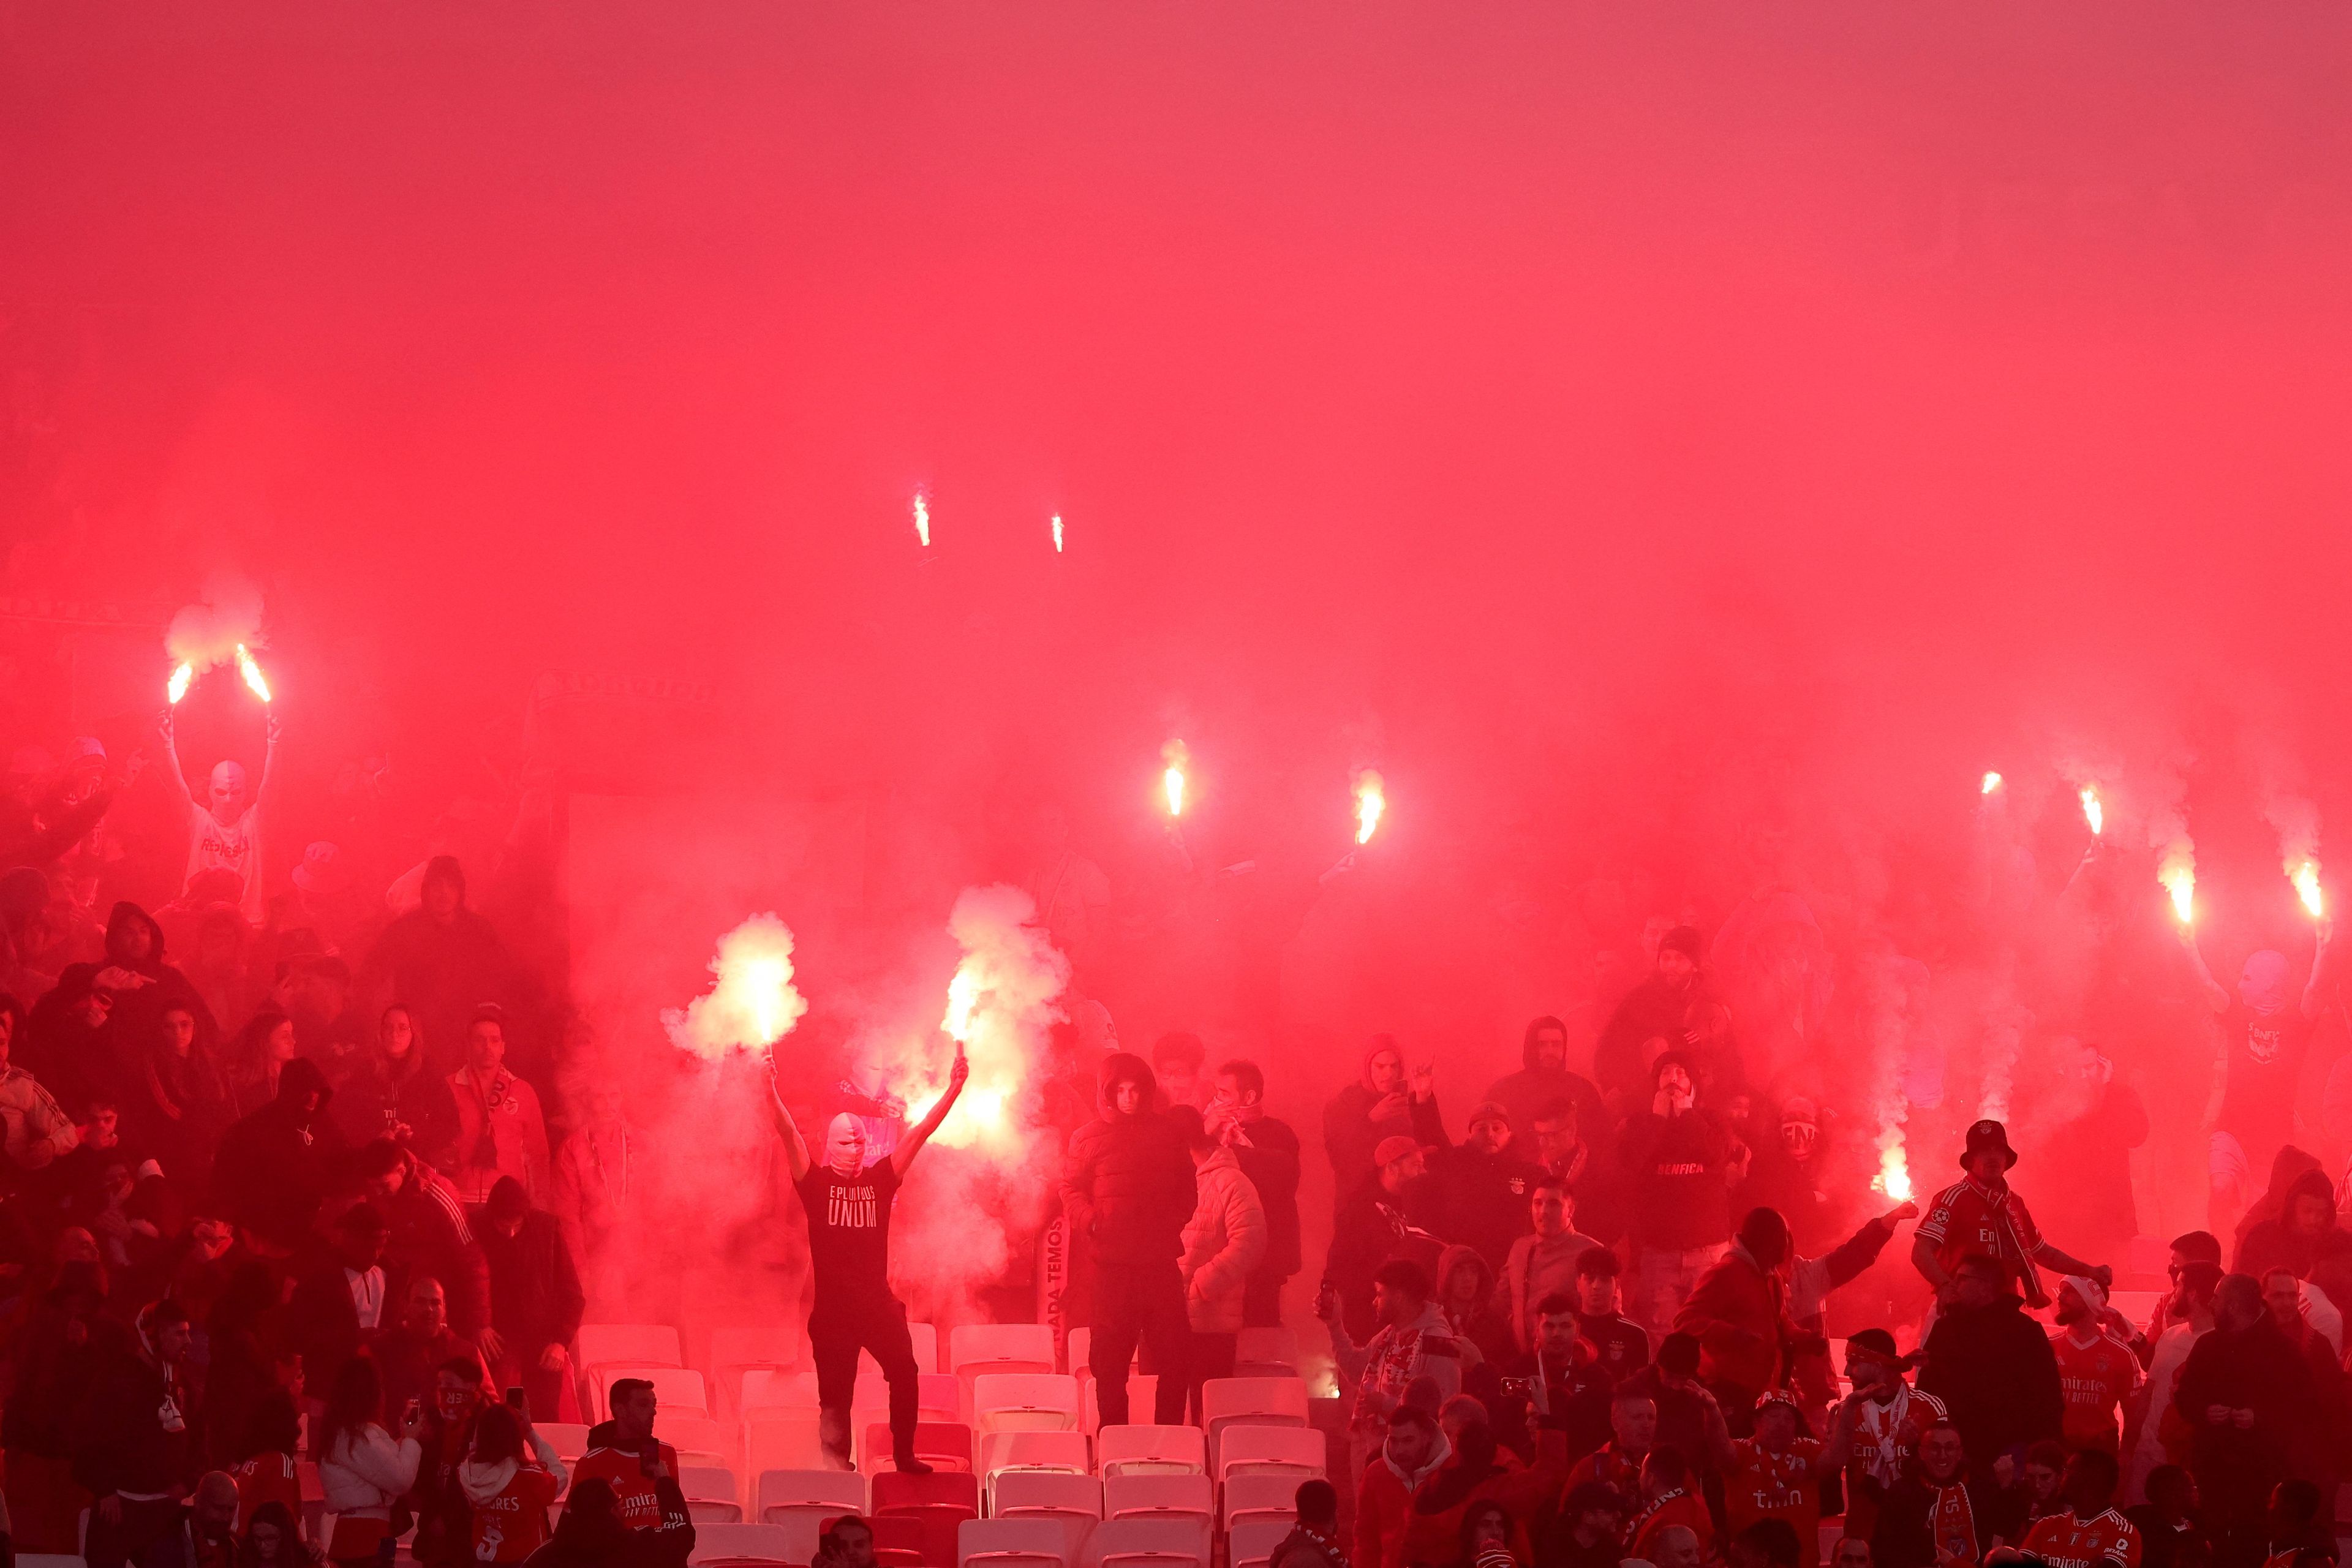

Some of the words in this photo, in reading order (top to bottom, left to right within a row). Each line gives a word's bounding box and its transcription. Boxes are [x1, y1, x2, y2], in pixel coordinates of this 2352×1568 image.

[1657, 1163, 1704, 1175] BENFICA
[827, 1198, 877, 1228] UNUM
[1047, 1221, 1063, 1283] TEMOS
[2061, 1375, 2108, 1393] mirates
[2041, 1553, 2090, 1568] Emirate
